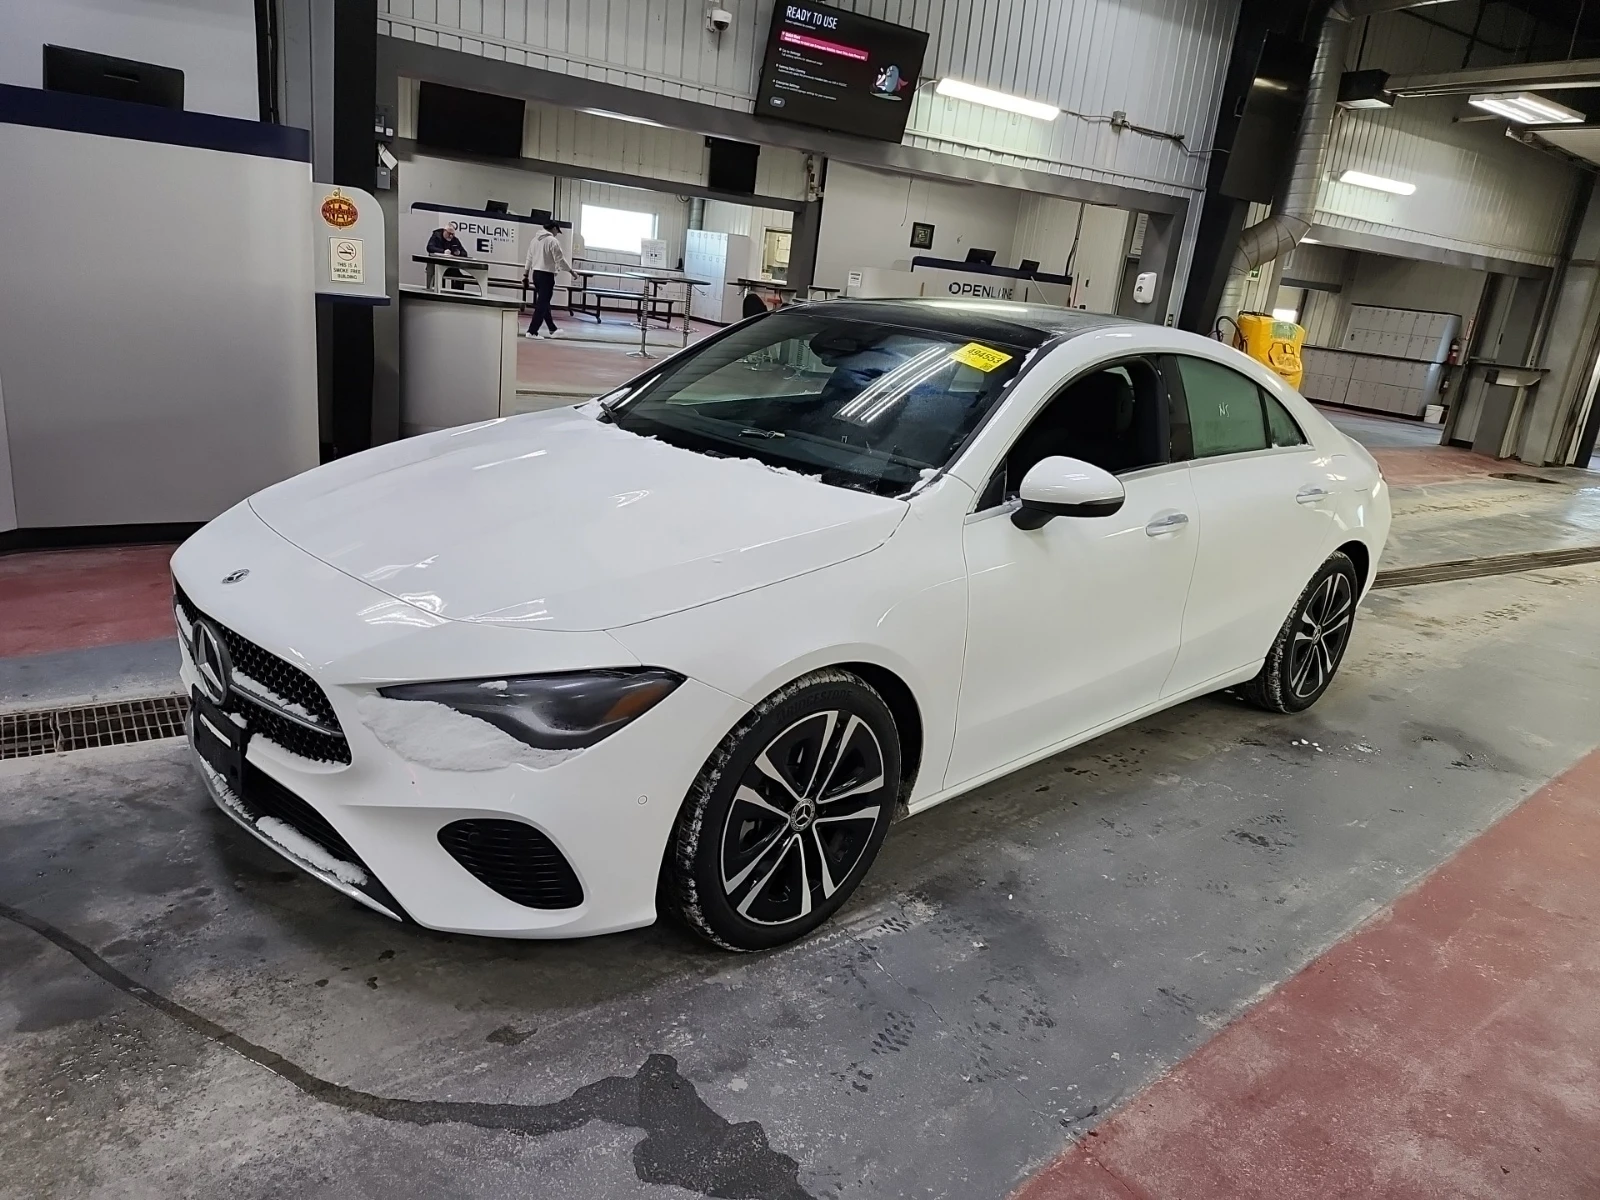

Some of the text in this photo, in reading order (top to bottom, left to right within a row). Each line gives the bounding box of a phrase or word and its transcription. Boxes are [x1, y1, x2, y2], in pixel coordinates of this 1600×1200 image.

[786, 5, 812, 22] READY
[813, 12, 823, 25] TO
[823, 15, 838, 30] USE
[967, 348, 1003, 364] 494553
